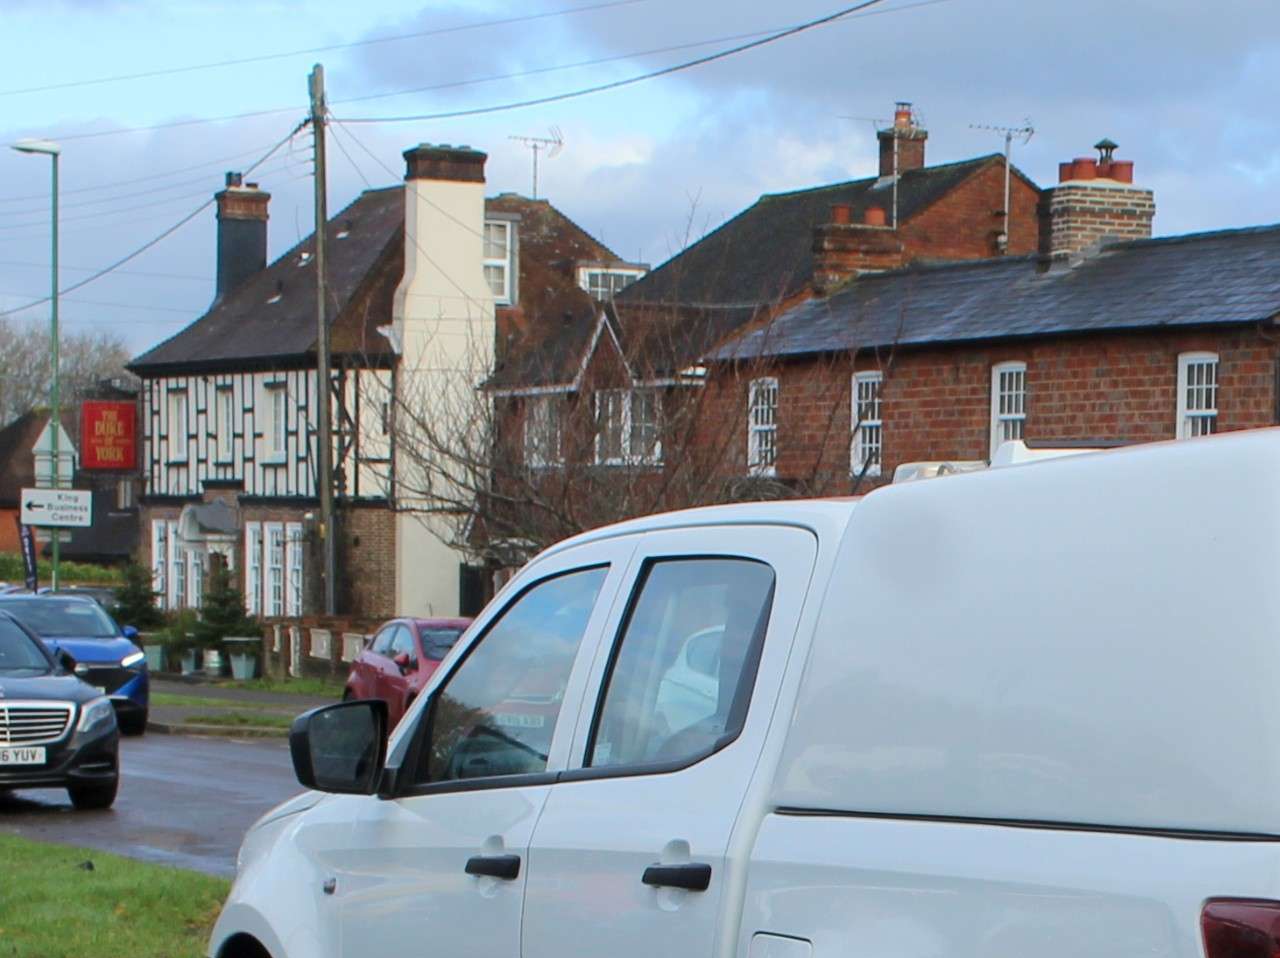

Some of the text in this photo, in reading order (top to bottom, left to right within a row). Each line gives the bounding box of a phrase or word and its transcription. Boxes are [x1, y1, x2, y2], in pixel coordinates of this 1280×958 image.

[95, 420, 124, 436] DUKE
[96, 447, 124, 461] YORK
[57, 494, 79, 504] King
[47, 503, 89, 513] Business
[51, 513, 84, 523] Centre
[12, 749, 38, 762] YUV
